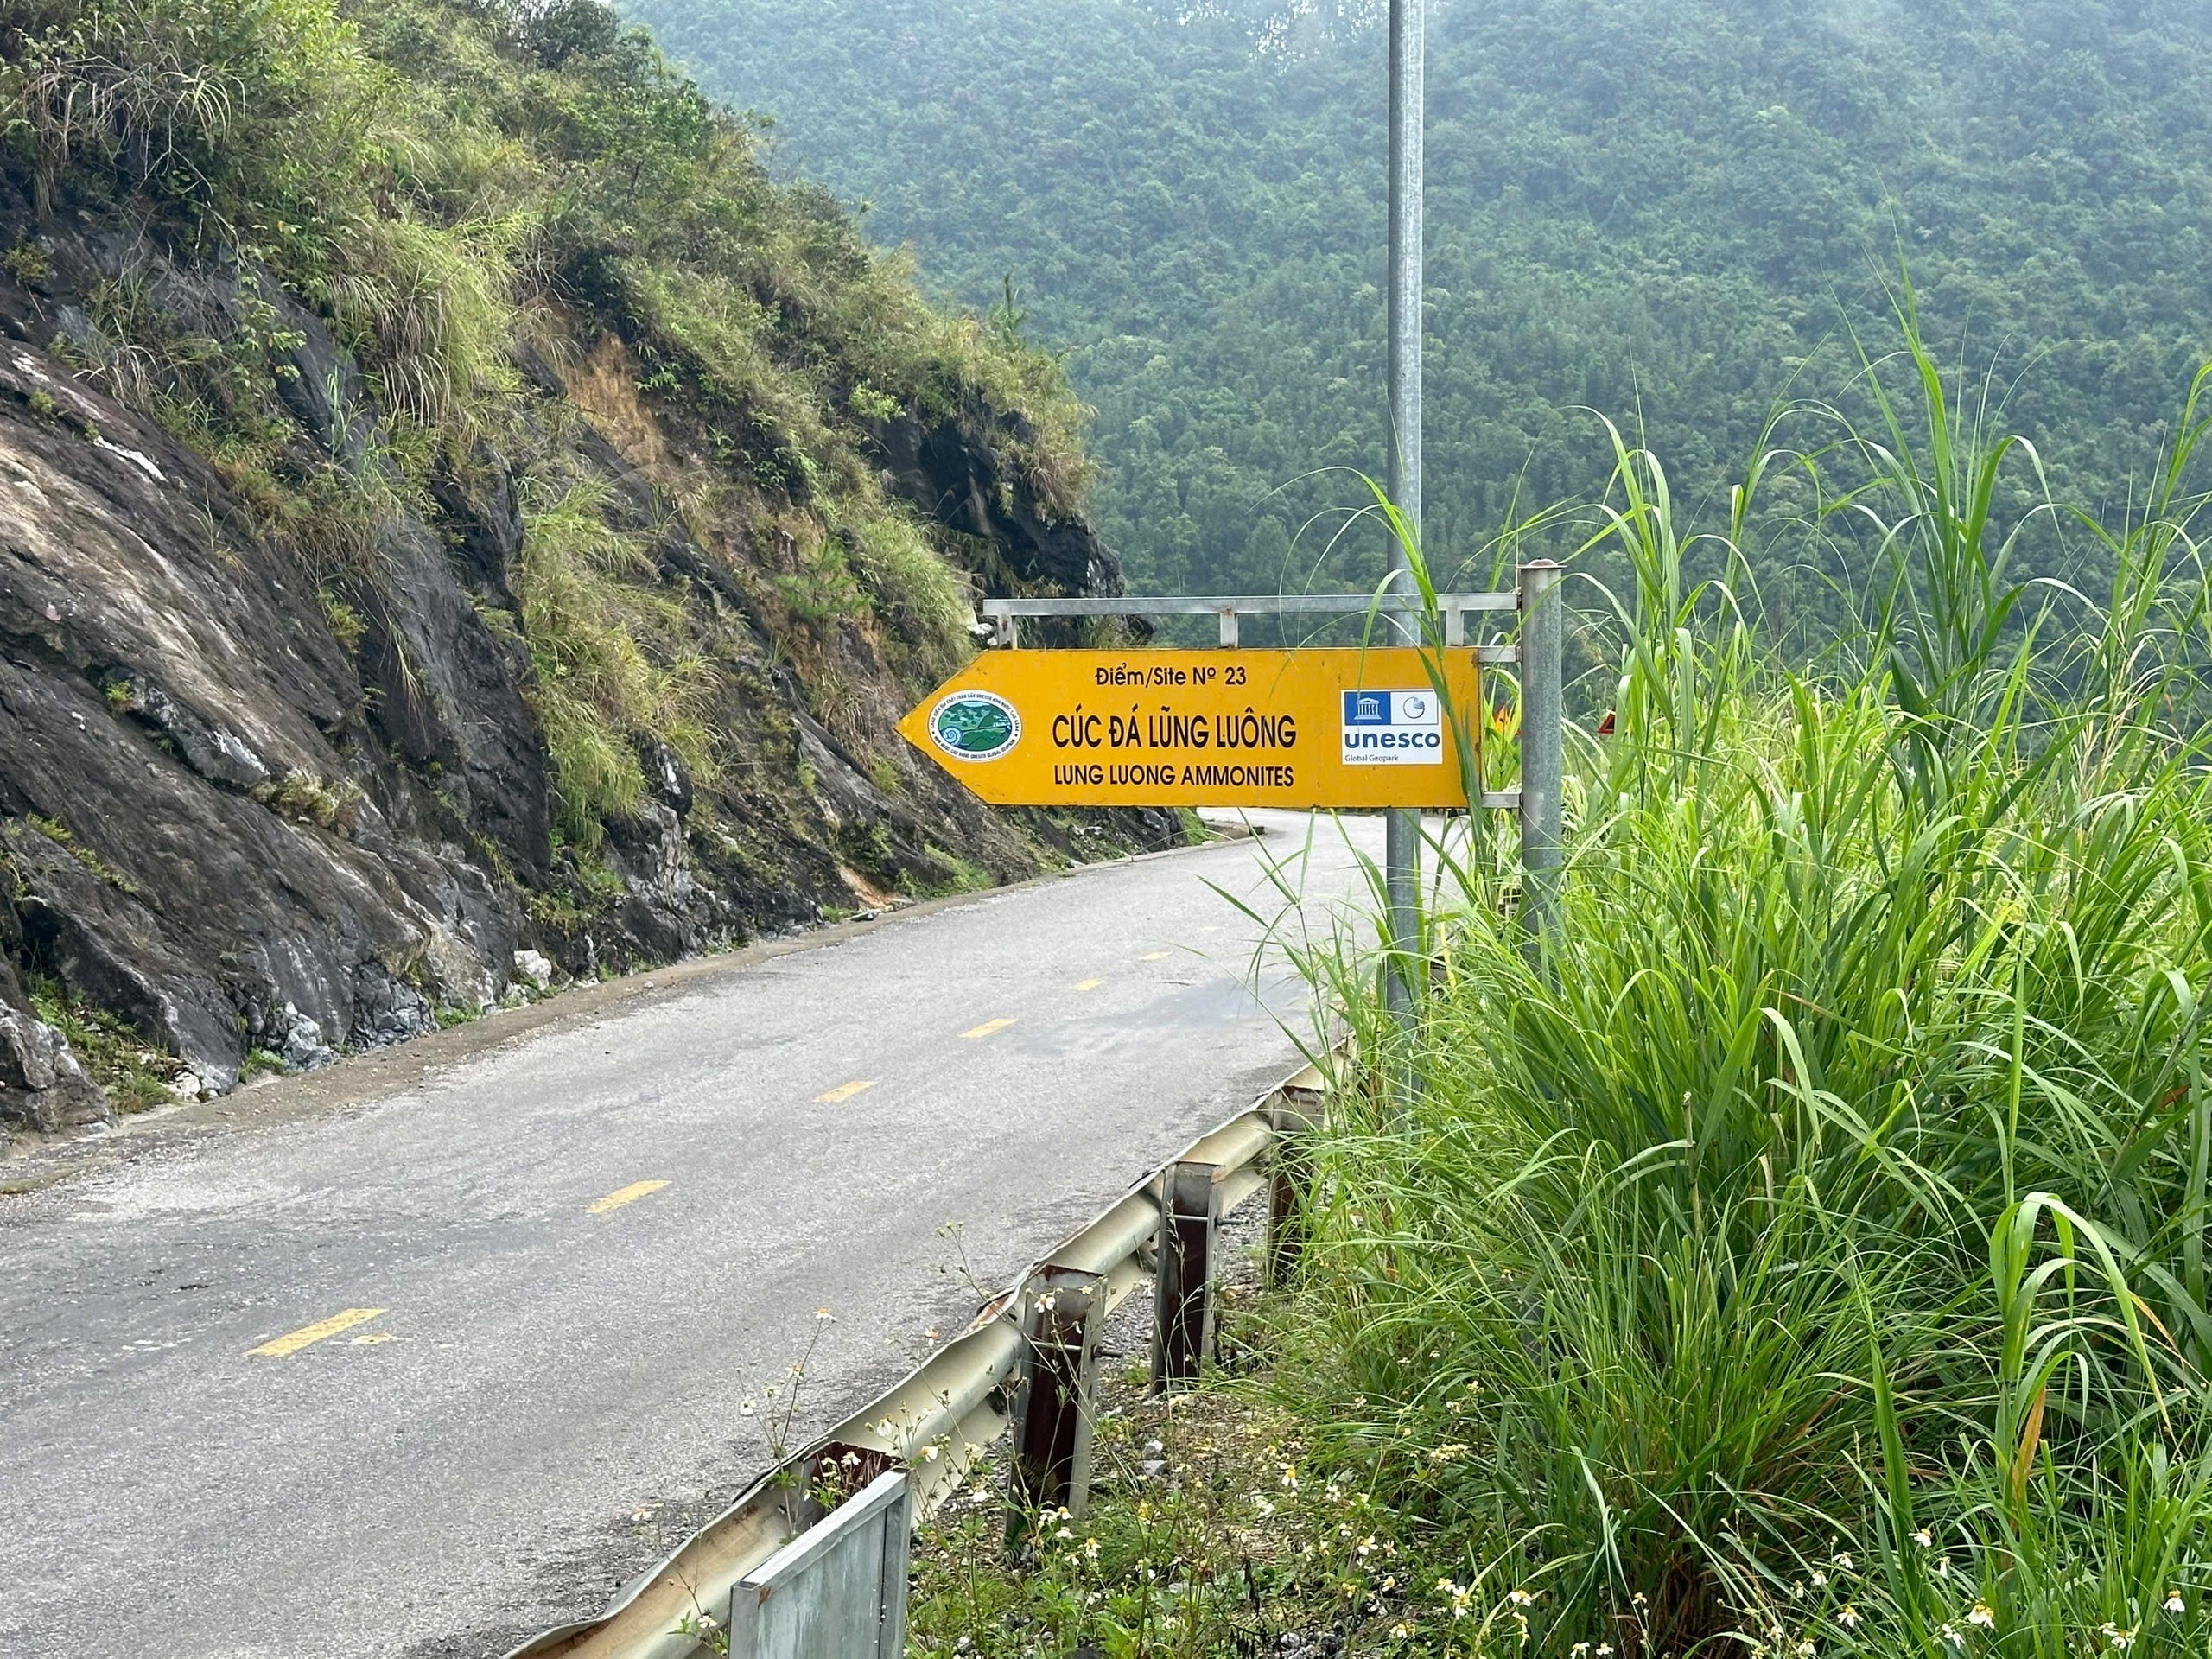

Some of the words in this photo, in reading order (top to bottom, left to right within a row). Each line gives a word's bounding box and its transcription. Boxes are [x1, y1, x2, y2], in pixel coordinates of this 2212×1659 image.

[1095, 662, 1186, 688] Điểm/Site
[1224, 666, 1247, 685] 23
[1052, 703, 1102, 748] CÚC
[1109, 703, 1141, 747] ĐÁ
[1149, 705, 1209, 748] LŨNG
[1217, 706, 1296, 748] LUÔNG
[1344, 733, 1440, 748] unesco
[1369, 754, 1399, 763] Geopark
[1054, 765, 1103, 785] LUNG
[1109, 765, 1175, 785] LUONG
[1181, 766, 1294, 787] AMMONITES
